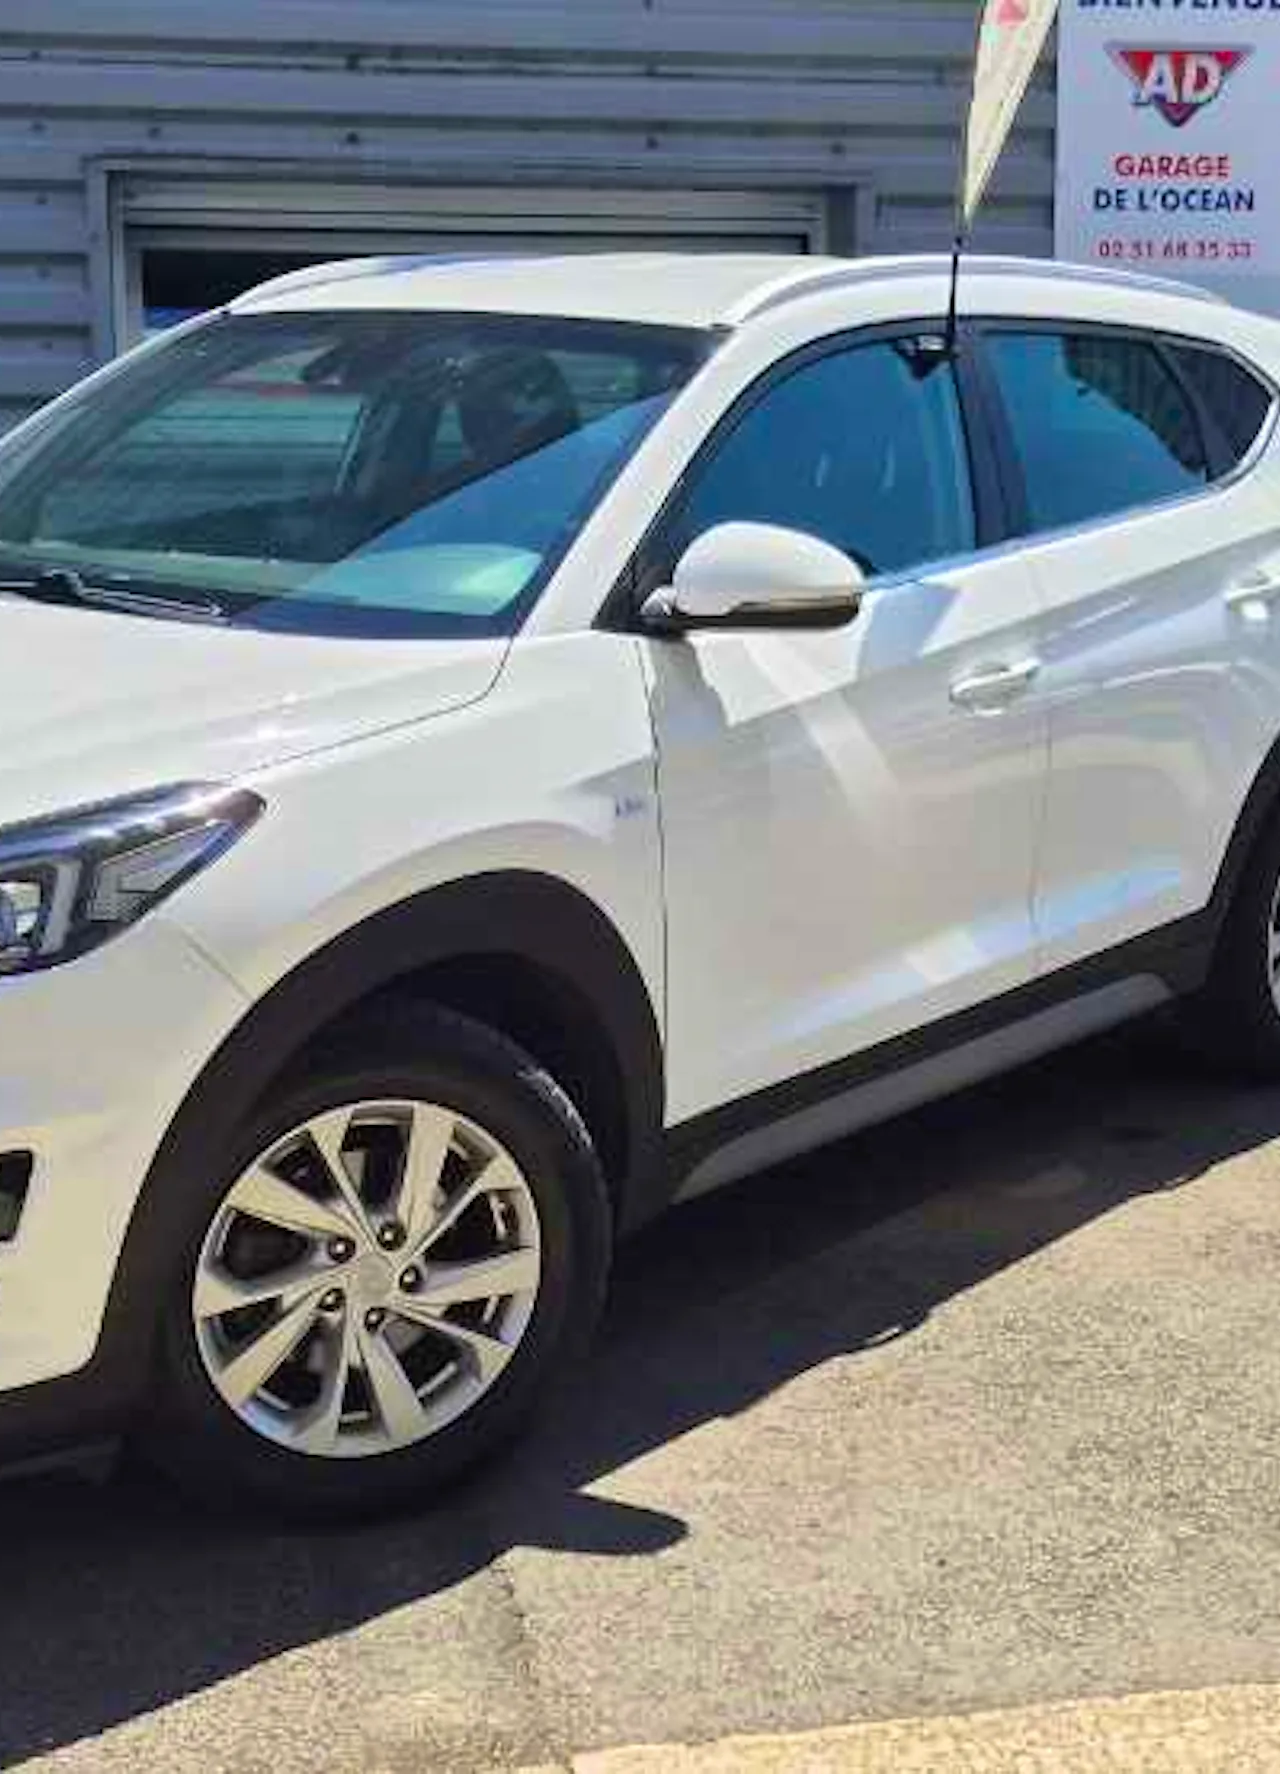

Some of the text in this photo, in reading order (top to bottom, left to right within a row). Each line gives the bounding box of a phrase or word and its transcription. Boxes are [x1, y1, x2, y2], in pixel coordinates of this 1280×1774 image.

[1136, 52, 1222, 104] AD
[1115, 155, 1230, 178] GARAGE
[1093, 188, 1256, 213] DE L'OCEAN
